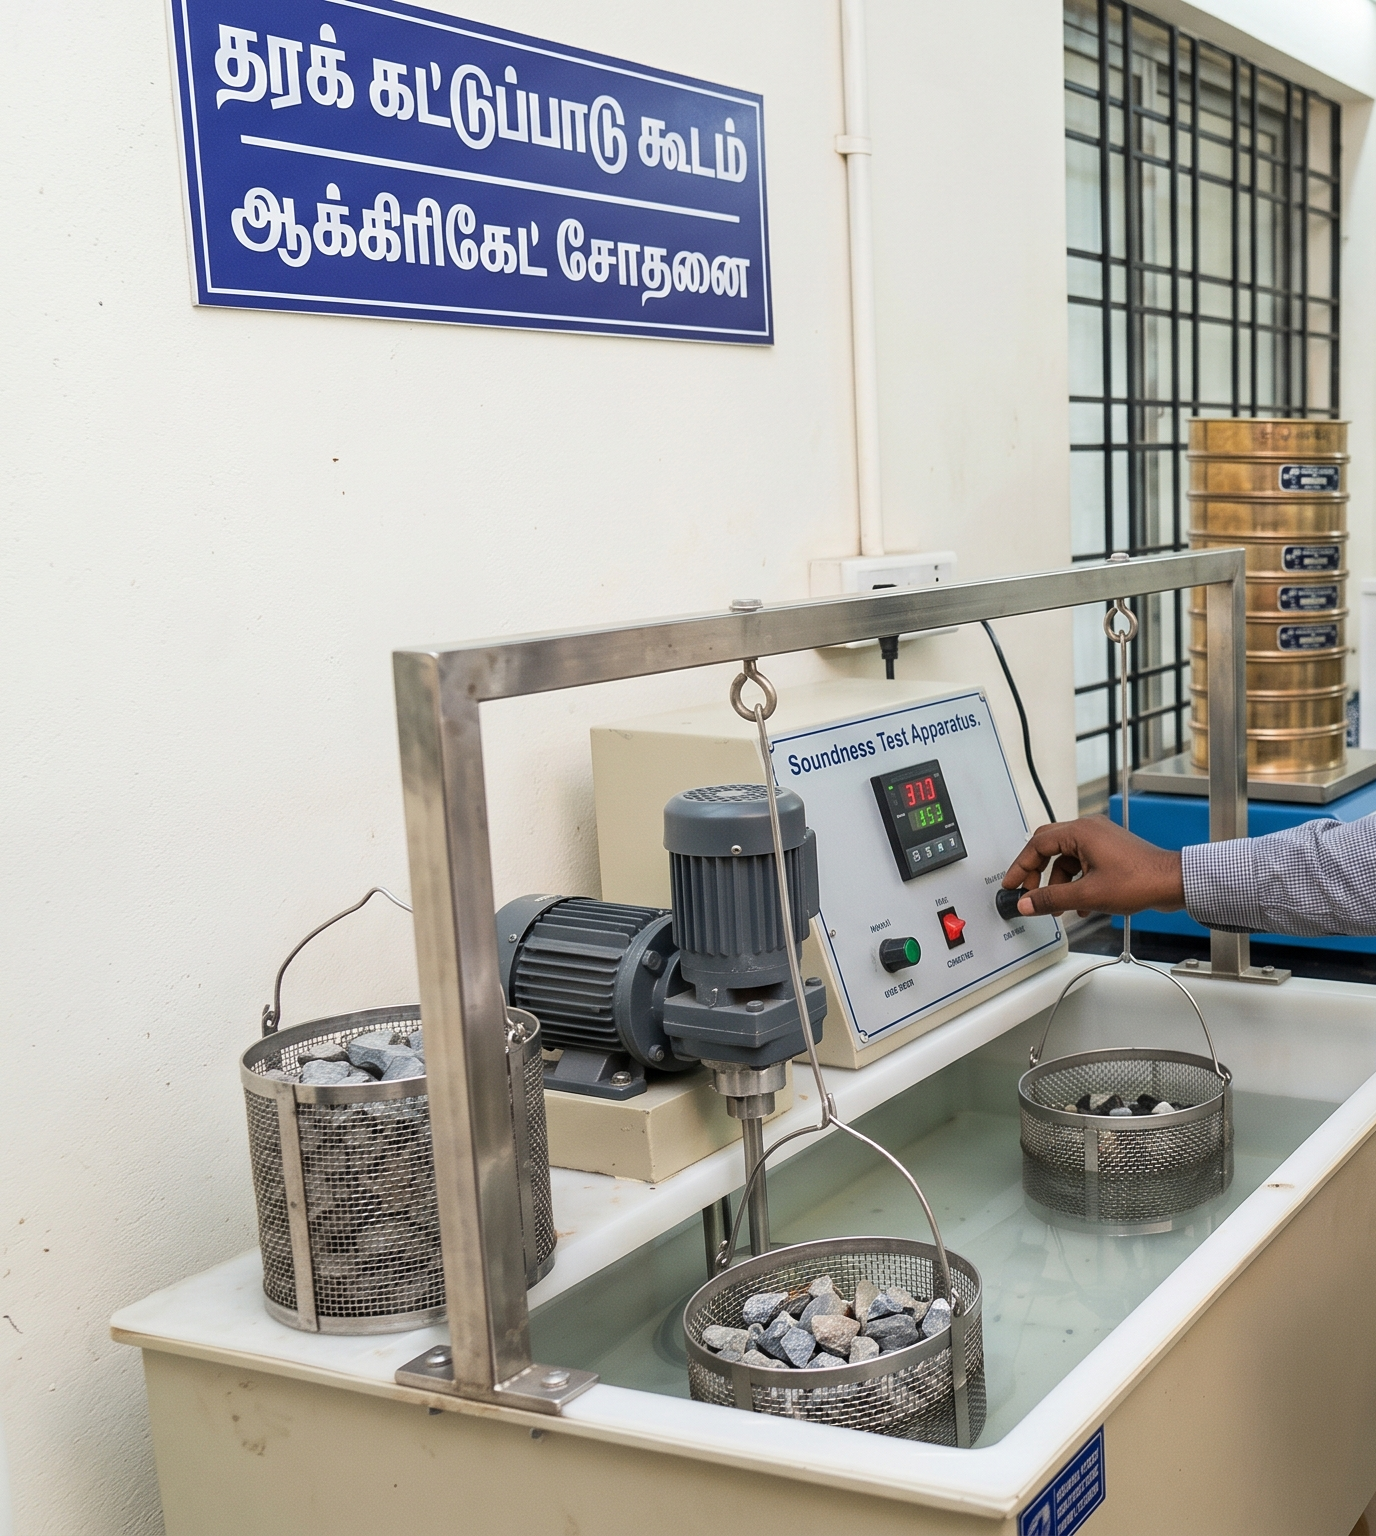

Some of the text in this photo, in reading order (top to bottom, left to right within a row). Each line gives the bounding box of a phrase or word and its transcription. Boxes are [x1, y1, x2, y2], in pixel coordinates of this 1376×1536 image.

[215, 23, 748, 184] தரக் கட்டுப்பாடு கூடம்
[231, 182, 751, 307] ஆக்கிரிகேட் சோதனை
[788, 712, 982, 776] Soundness Test Apparatus.
